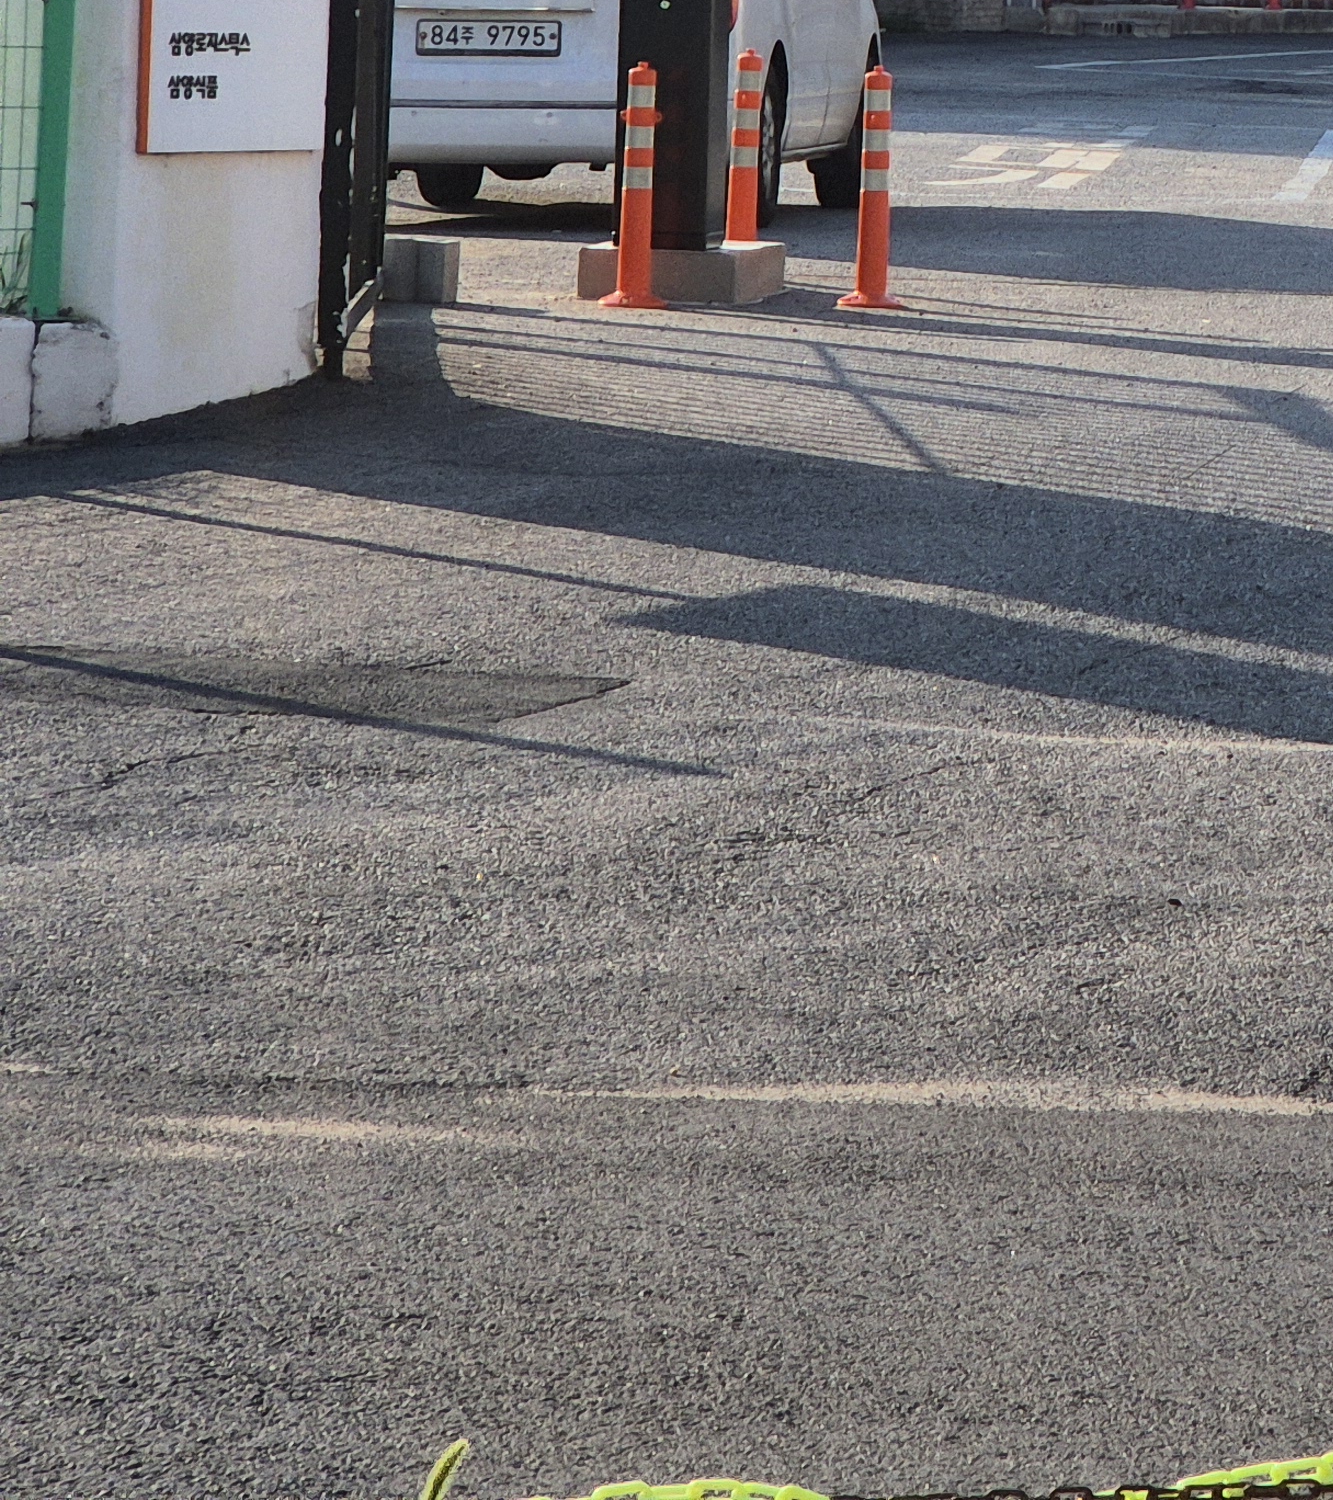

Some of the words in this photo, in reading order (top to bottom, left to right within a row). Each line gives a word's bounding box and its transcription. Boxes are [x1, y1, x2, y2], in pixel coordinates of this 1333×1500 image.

[168, 32, 251, 57] 삼양로지스틱스
[430, 25, 475, 46] 84주
[486, 25, 547, 46] 9795
[167, 75, 219, 100] 삼양식품
